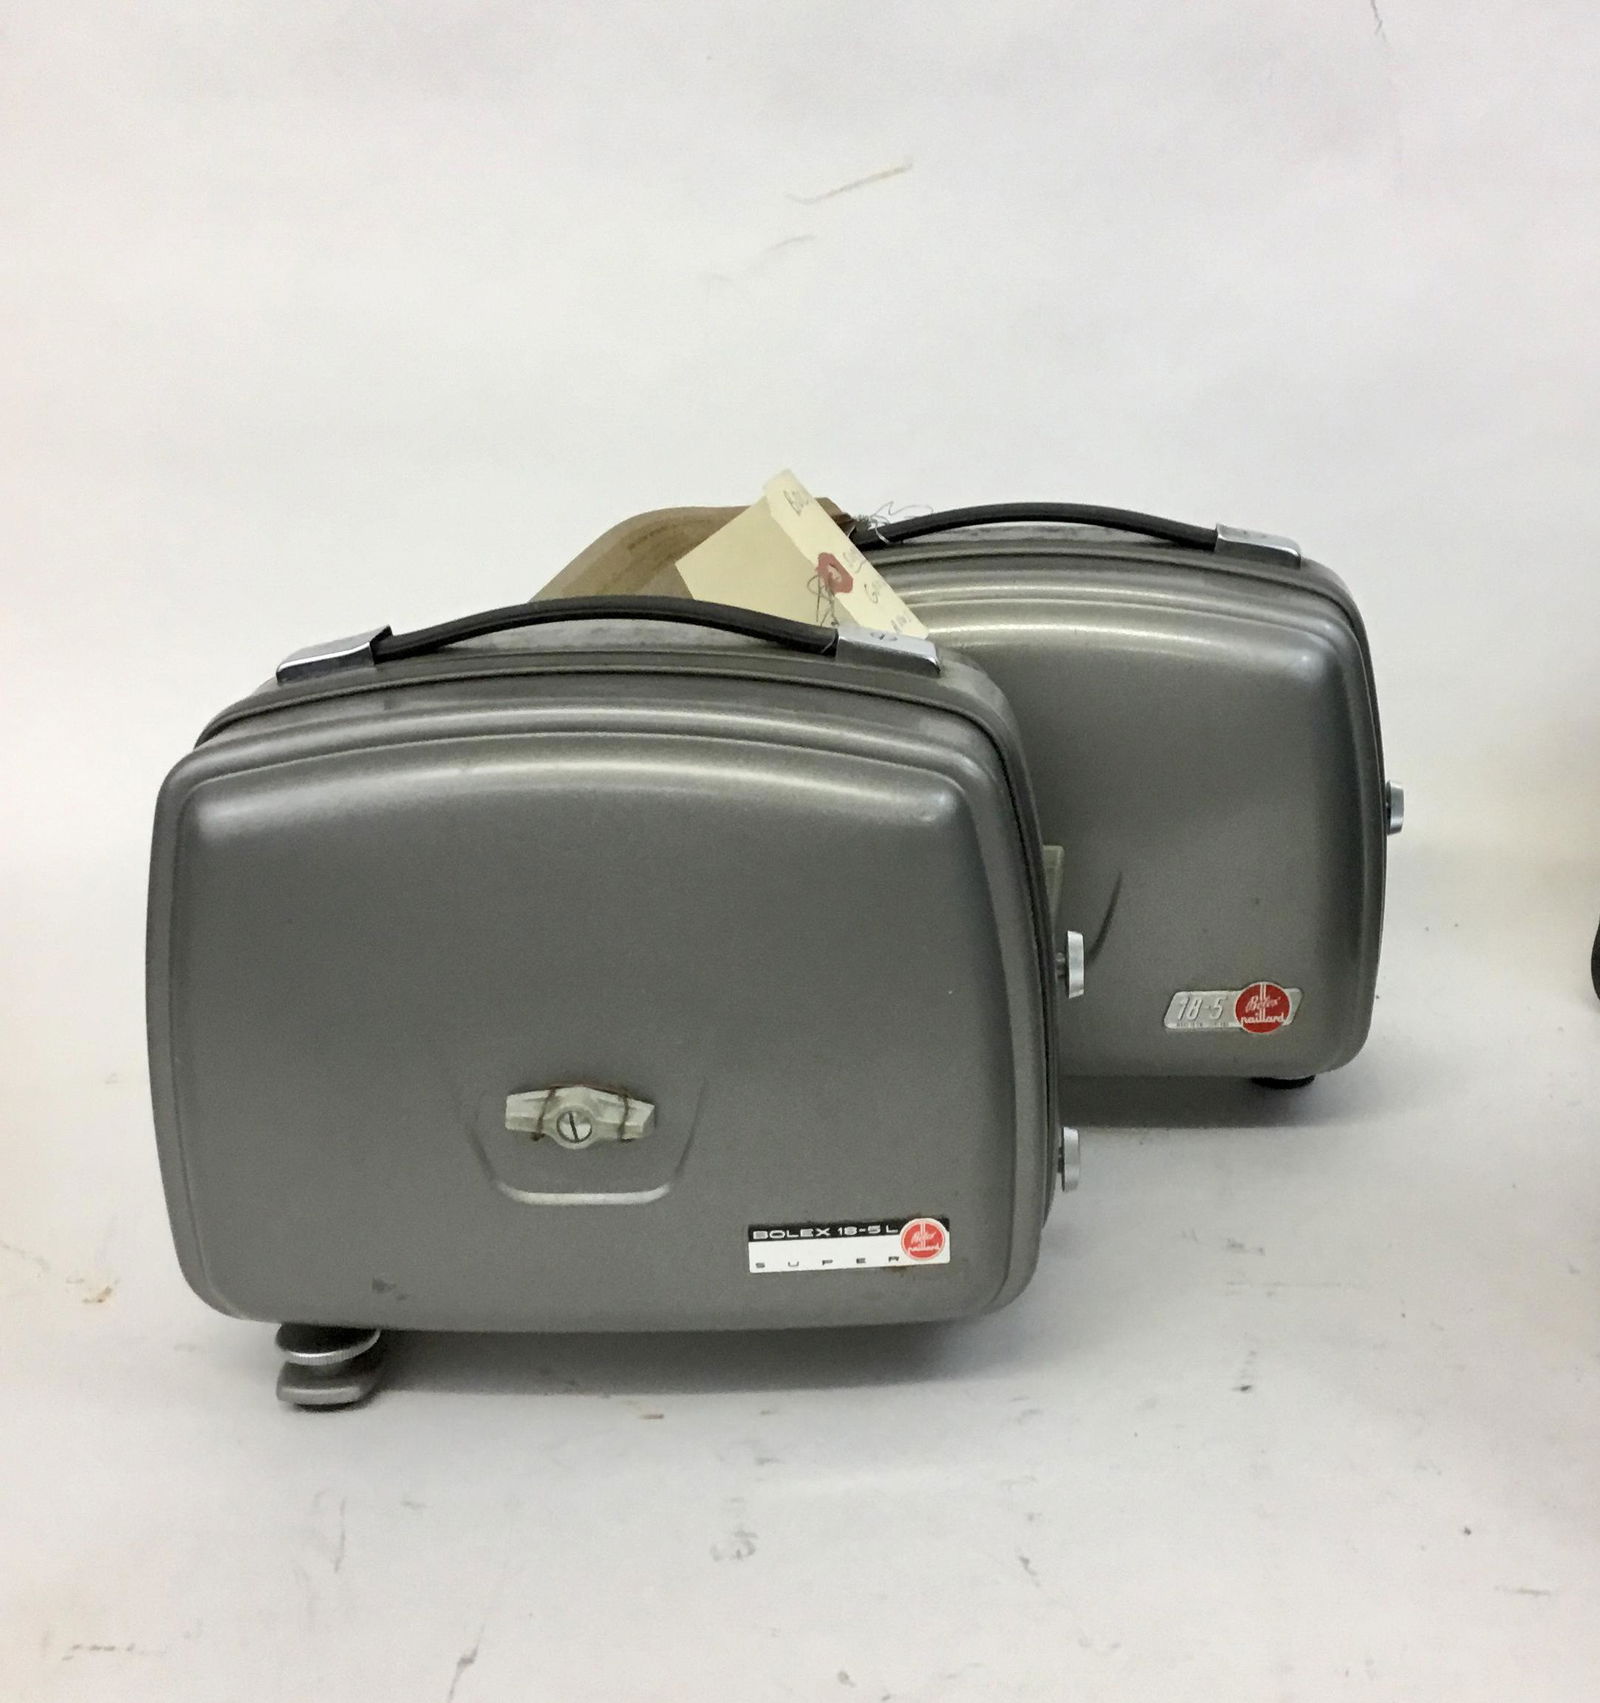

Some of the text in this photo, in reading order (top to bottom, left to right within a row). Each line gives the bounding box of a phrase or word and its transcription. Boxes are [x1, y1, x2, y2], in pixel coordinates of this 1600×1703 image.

[1177, 997, 1228, 1021] 18-5
[752, 1224, 899, 1239] BOLEX 18-5 L
[755, 1255, 900, 1269] SUPER
